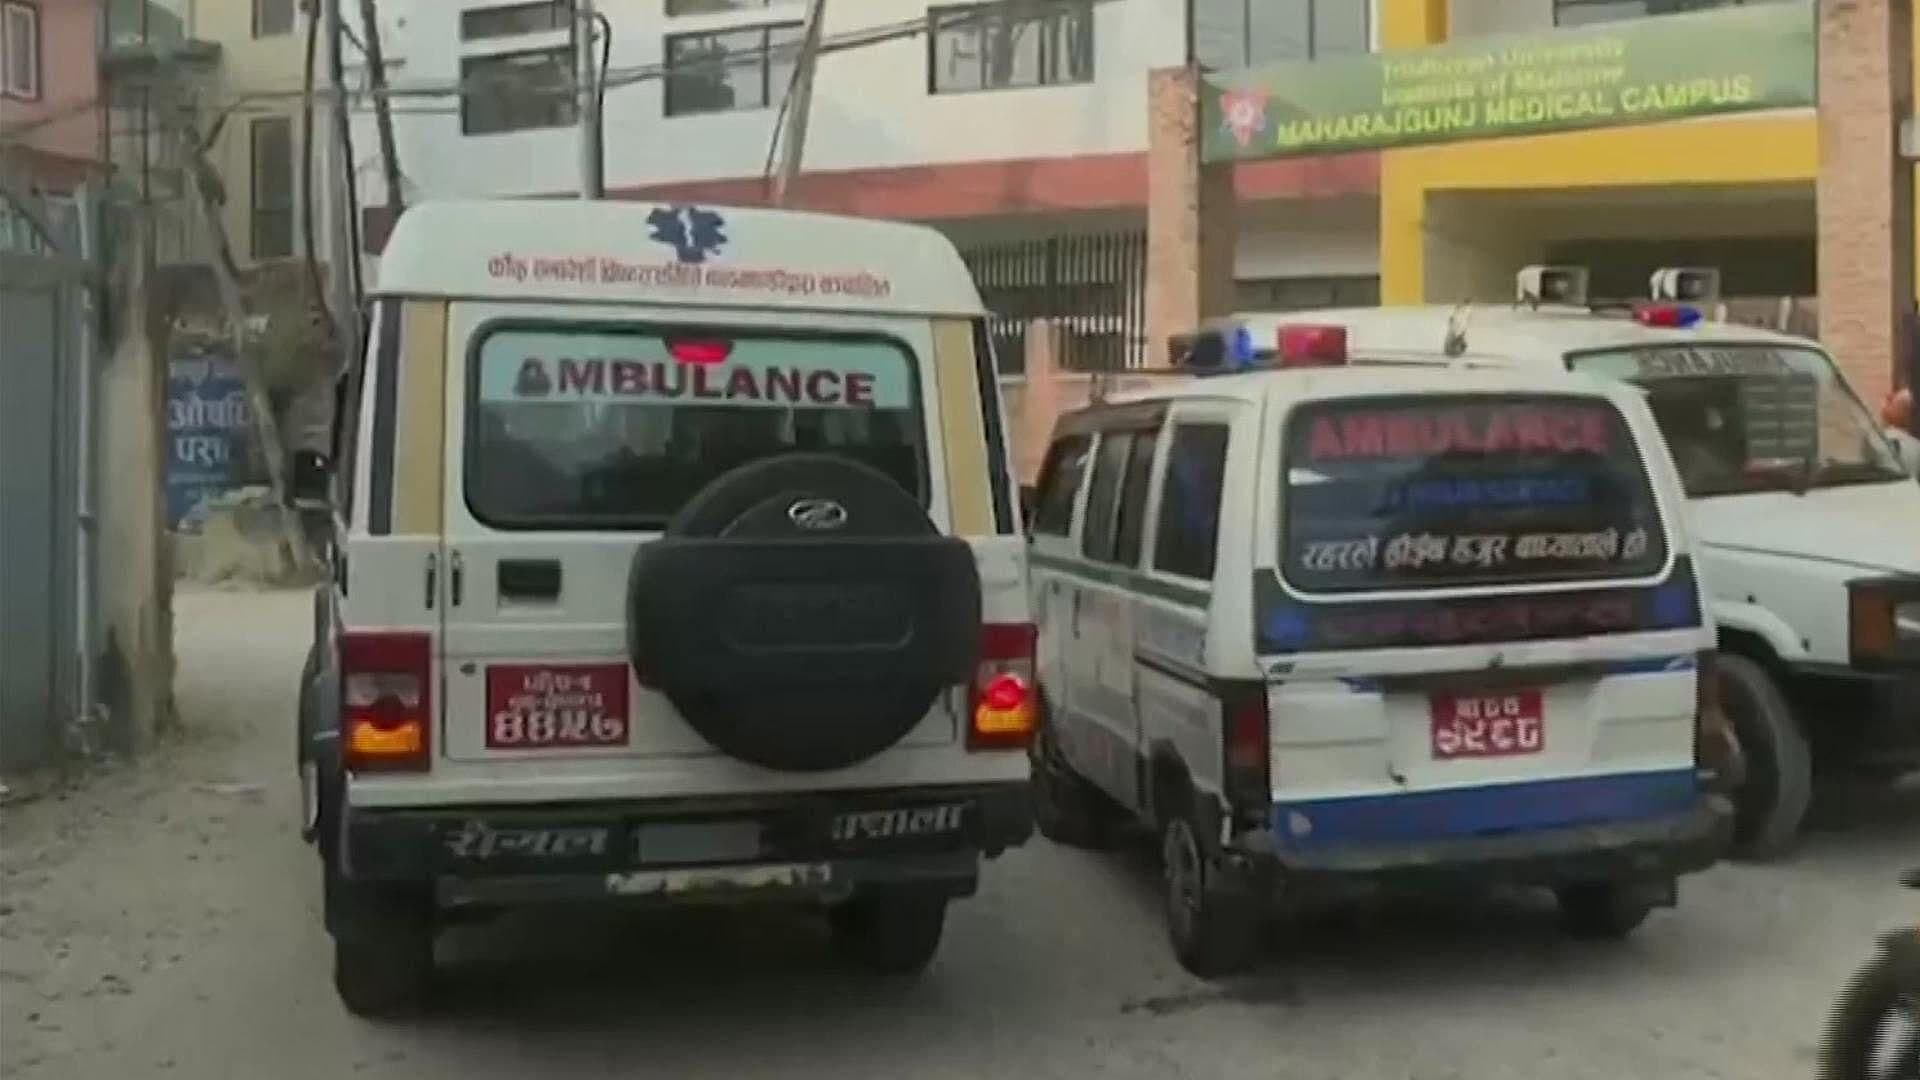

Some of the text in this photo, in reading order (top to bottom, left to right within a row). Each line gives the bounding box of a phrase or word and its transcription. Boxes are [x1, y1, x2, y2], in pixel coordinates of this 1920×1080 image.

[1502, 37, 1624, 66] University
[1277, 74, 1752, 146] MAHARAJGUNJ MEDICAL CAMPUS
[513, 357, 876, 405] AMBULANCE
[1311, 410, 1609, 459] AMBULANCE
